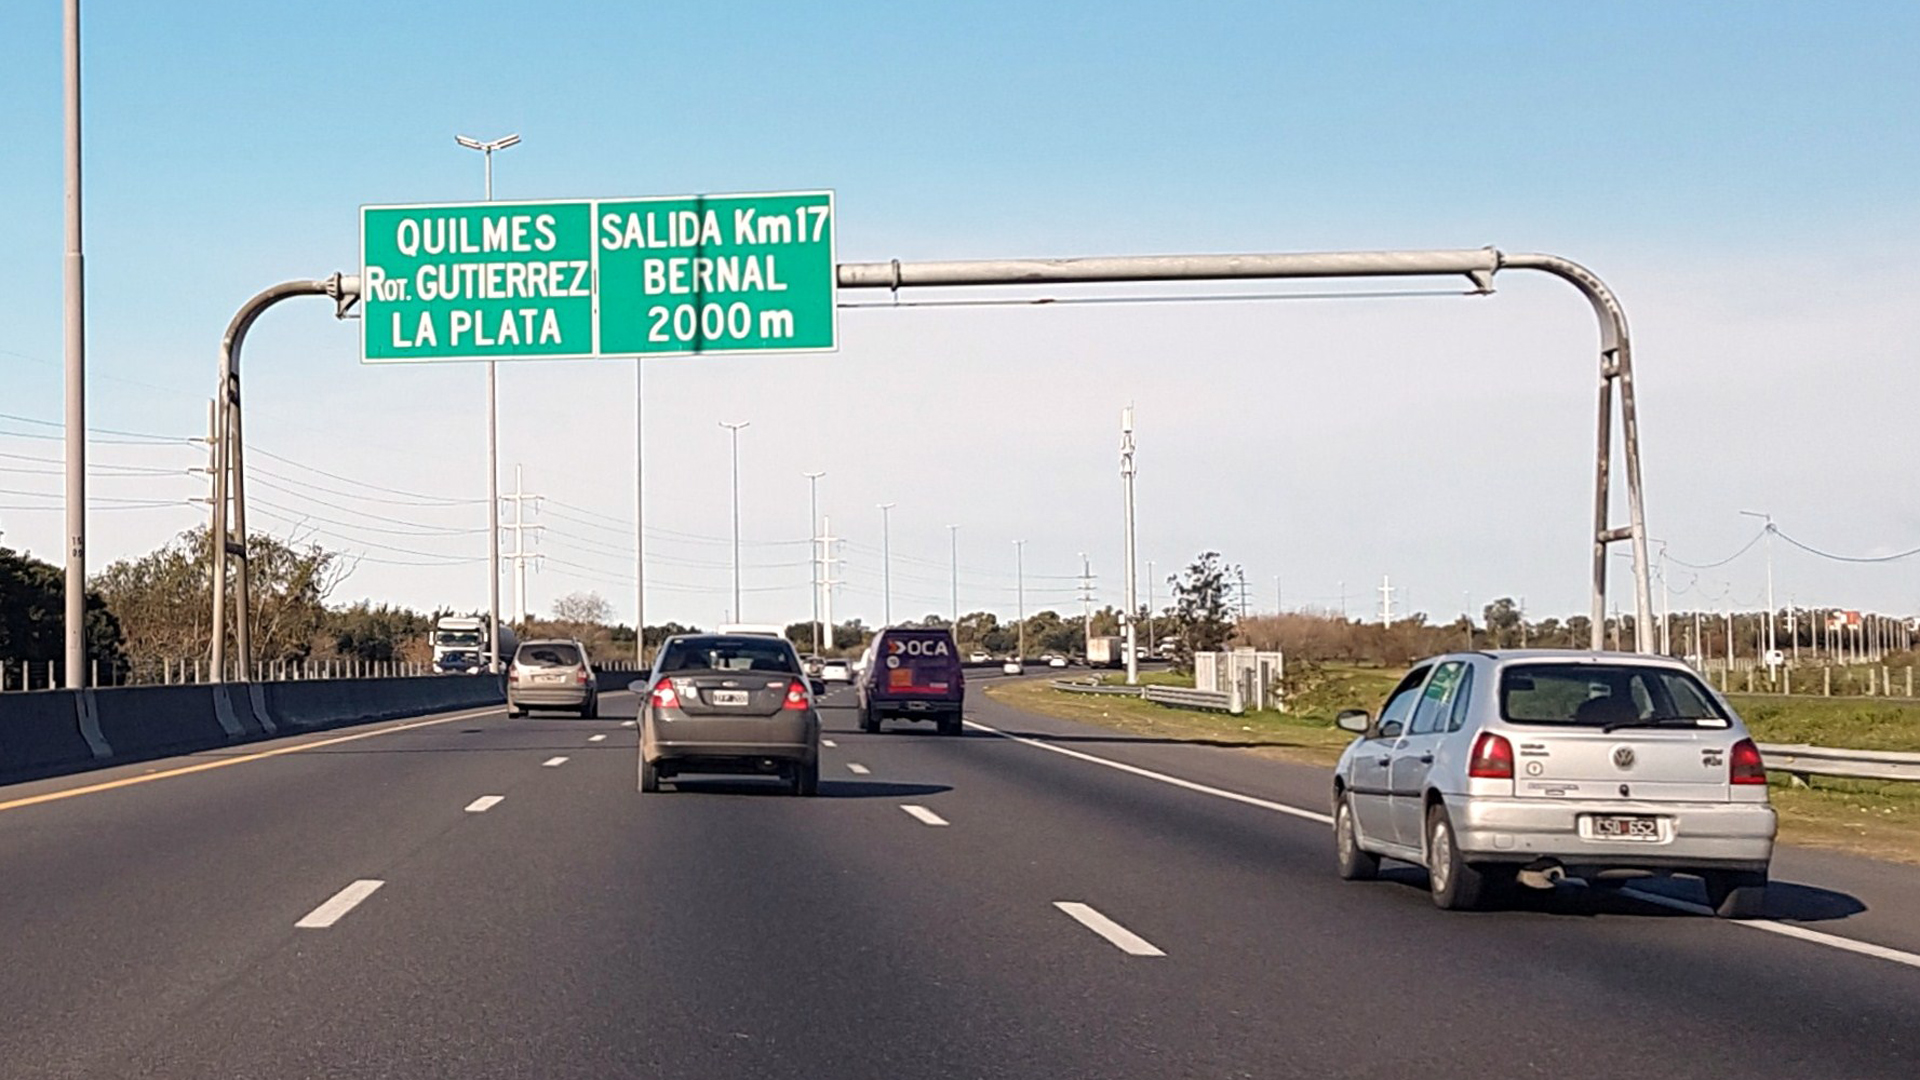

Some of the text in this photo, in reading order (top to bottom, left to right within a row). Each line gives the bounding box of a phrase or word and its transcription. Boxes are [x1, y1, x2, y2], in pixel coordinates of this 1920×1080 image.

[396, 213, 557, 257] QUILMES
[601, 209, 723, 250] SALIDA
[416, 260, 590, 301] GUTIERREZ
[643, 254, 788, 295] BERNAL
[392, 307, 562, 348] LA PLATA
[647, 301, 794, 342] 2000 m
[907, 640, 949, 656] OCA
[1628, 820, 1655, 836] 652
